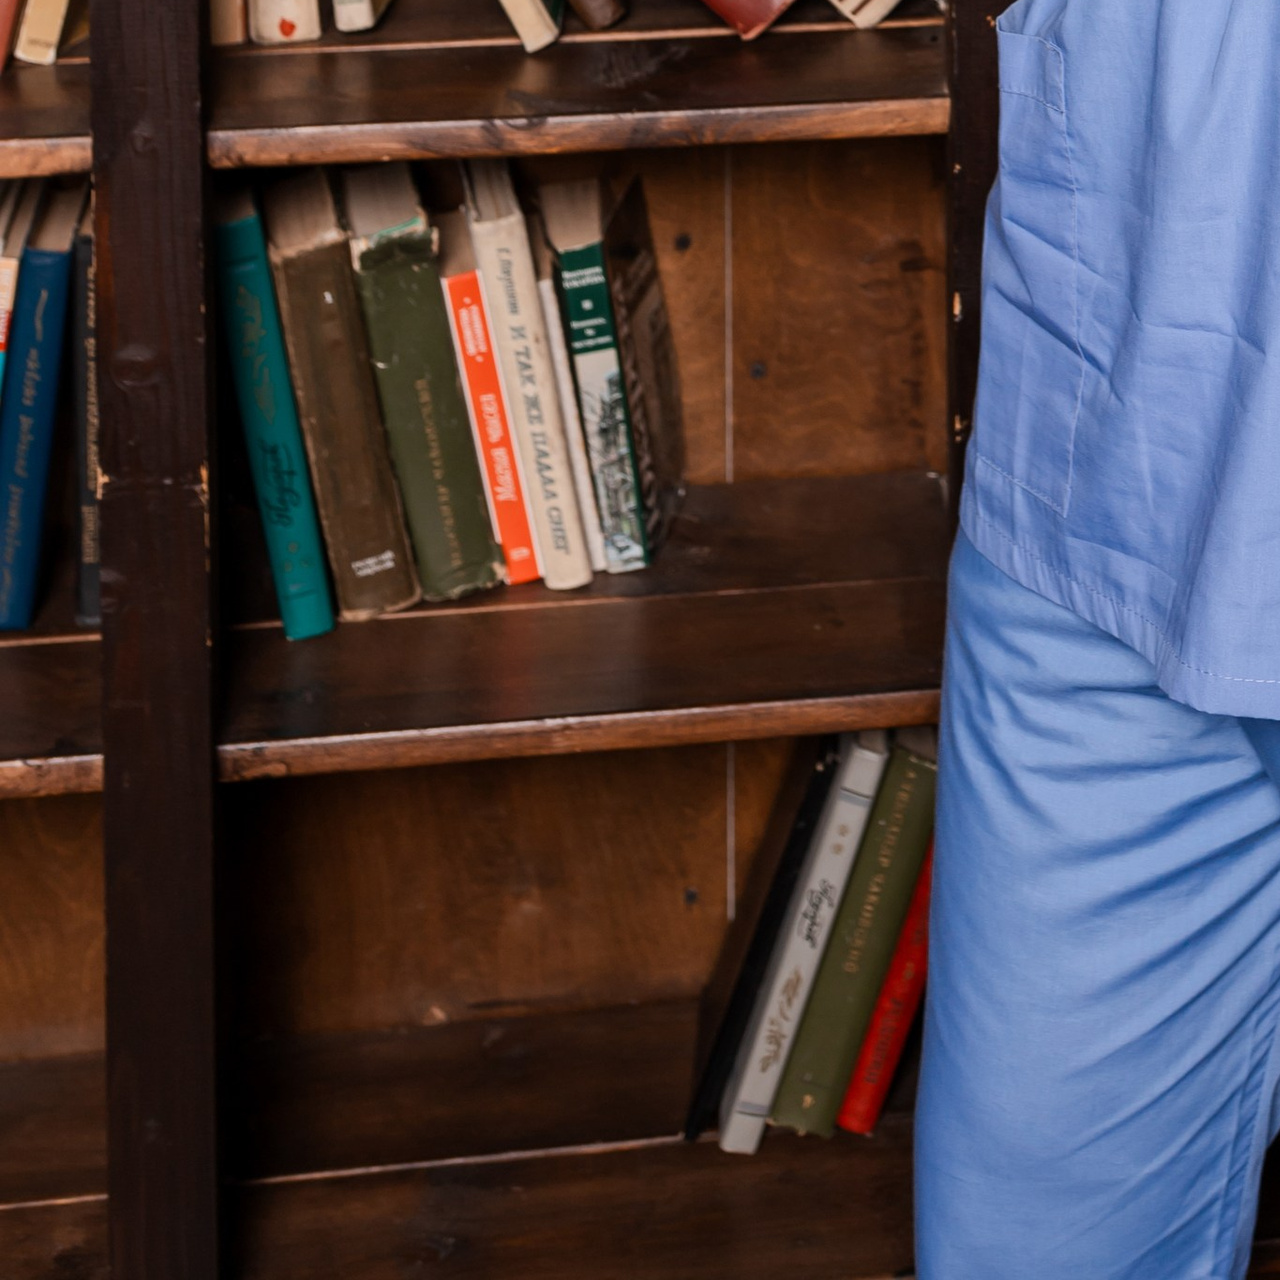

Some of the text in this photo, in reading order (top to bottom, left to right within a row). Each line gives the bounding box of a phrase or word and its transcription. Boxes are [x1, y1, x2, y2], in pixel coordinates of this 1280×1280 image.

[509, 323, 526, 340] И
[513, 345, 537, 388] ТАК
[523, 389, 544, 426] ЖЕ
[529, 429, 559, 501] ПАДАЛ
[545, 505, 570, 557] СНЕГ
